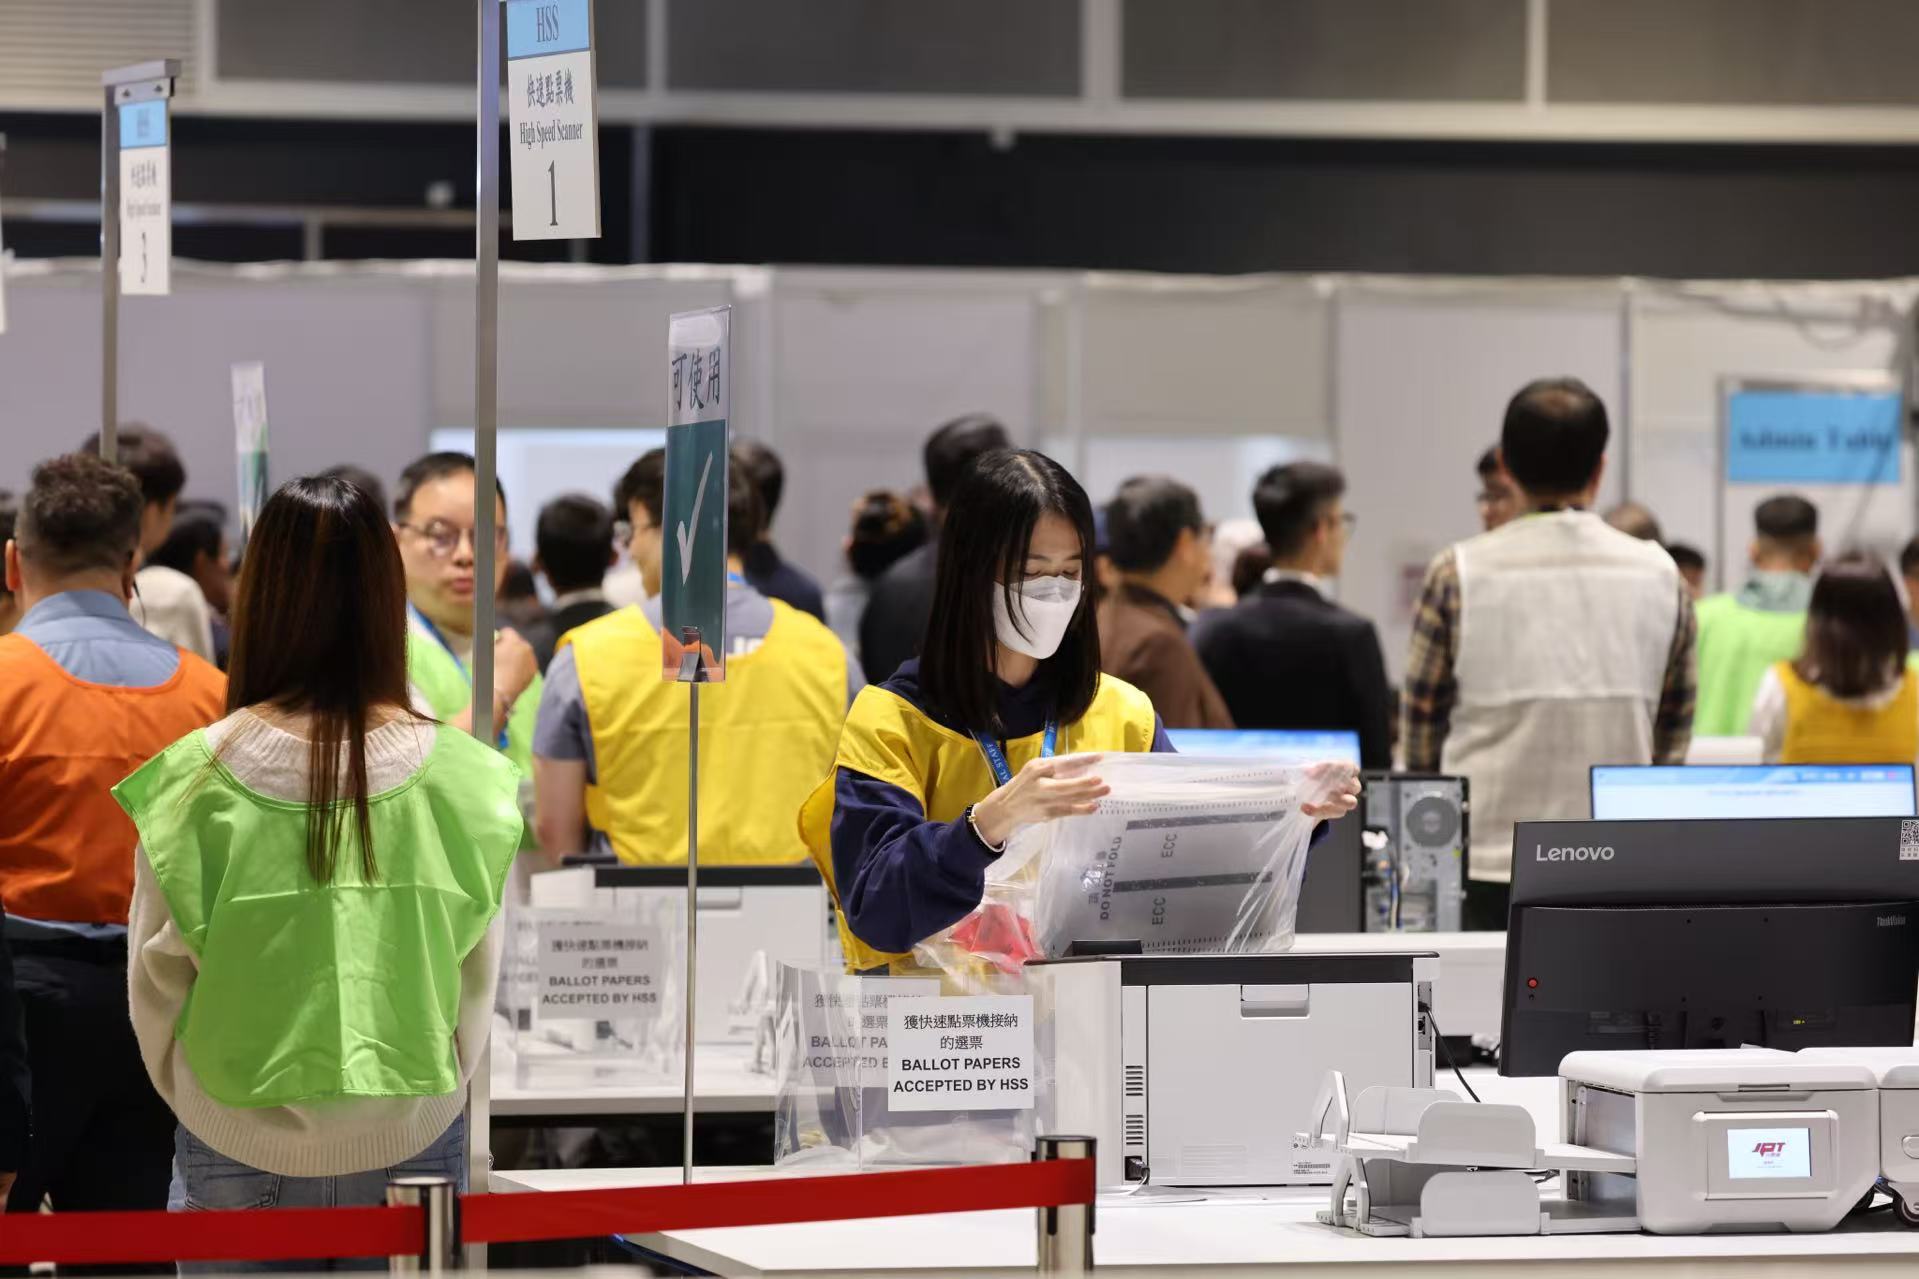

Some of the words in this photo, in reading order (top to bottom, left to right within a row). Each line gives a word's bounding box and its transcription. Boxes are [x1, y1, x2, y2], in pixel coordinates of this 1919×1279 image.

[536, 4, 560, 42] HSS
[526, 68, 575, 108] 快速點票機
[519, 121, 535, 150] High
[536, 119, 556, 149] Speed
[557, 119, 583, 142] Scanner
[547, 160, 559, 226] 1
[671, 346, 721, 411] 可使用
[1107, 837, 1122, 868] FOLD
[1161, 832, 1177, 858] ECC
[1536, 844, 1615, 861] Lenovo
[1102, 871, 1115, 899] NOT
[1100, 901, 1111, 920] DO
[1152, 897, 1166, 925] ECC
[549, 976, 598, 986] BALLOT
[601, 975, 651, 986] PAPERS
[542, 994, 609, 1005] ACCEPTED
[612, 993, 629, 1003] BY
[632, 992, 657, 1003] HSS
[904, 1013, 1018, 1029] 獲快速點票機接納
[940, 1035, 983, 1050] 的選票
[901, 1058, 960, 1071] BALLOT
[964, 1057, 1021, 1070] PAPERS
[893, 1079, 973, 1093] ACCEPTED
[976, 1079, 996, 1091] BY
[1000, 1078, 1029, 1091] HSS
